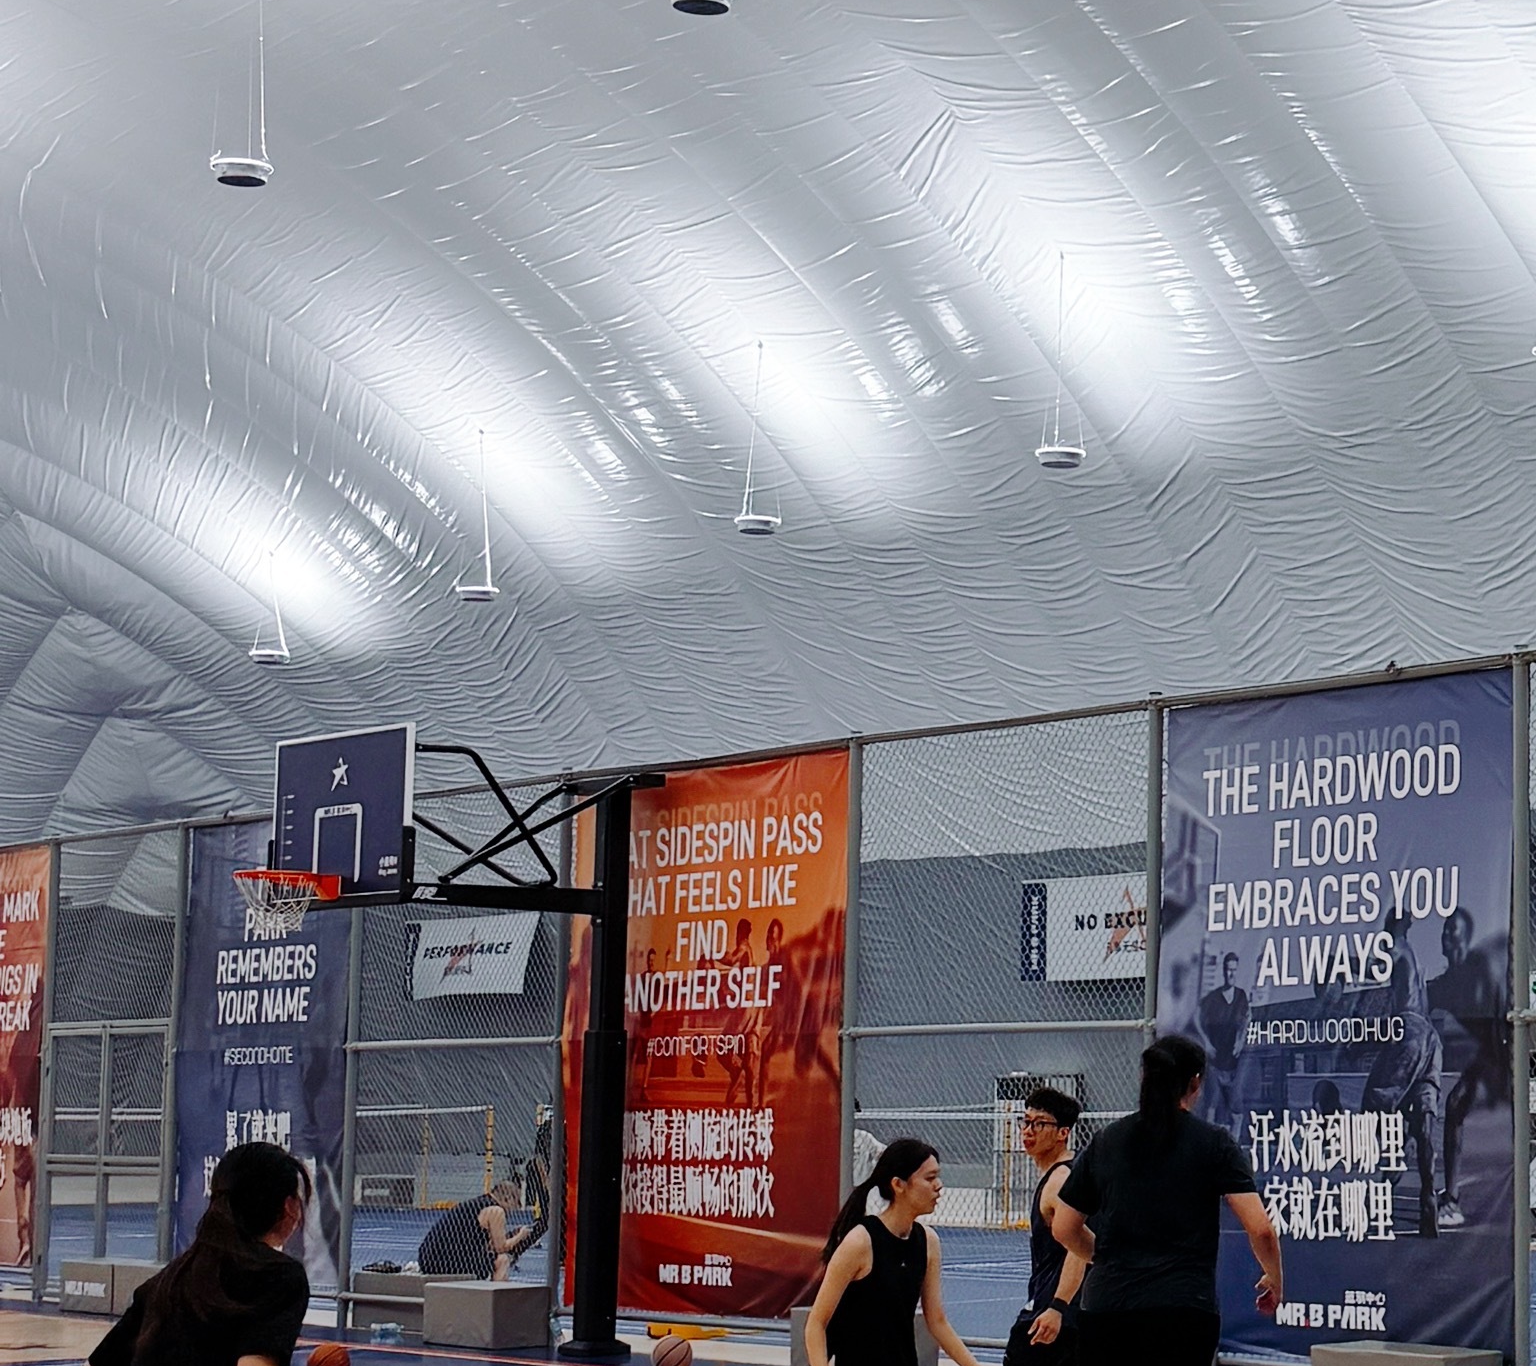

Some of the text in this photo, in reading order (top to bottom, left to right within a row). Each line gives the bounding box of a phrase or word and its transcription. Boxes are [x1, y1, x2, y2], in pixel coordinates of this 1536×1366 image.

[1203, 743, 1462, 817] THE HARDWOOD
[656, 818, 755, 868] SIDESPIN
[762, 811, 823, 858] PASS
[1272, 812, 1379, 869] FLOOR
[2, 889, 40, 924] MARK
[627, 863, 799, 917] HAT FEELS LIKE
[1207, 865, 1459, 933] EMBRACES YOU
[675, 919, 728, 963] FIND
[1074, 910, 1147, 931] NO EXCU
[23, 963, 39, 994] IN
[216, 944, 317, 985] REMEMBERS
[1256, 930, 1394, 987] ALWAYS
[217, 986, 311, 1025] YOUR NAME
[624, 965, 782, 1013] ANOTHER SELF
[0, 999, 33, 1032] REAK
[1247, 1016, 1405, 1045] #HARDWOODHUG
[223, 1046, 293, 1066] #SECONDHOME
[646, 1033, 746, 1057] #COMFORTSPIN
[1248, 1108, 1409, 1174] 汗水流到哪里
[1263, 1175, 1396, 1242] 家就在哪里
[693, 1265, 732, 1286] PARK
[1327, 1304, 1386, 1331] PARK
